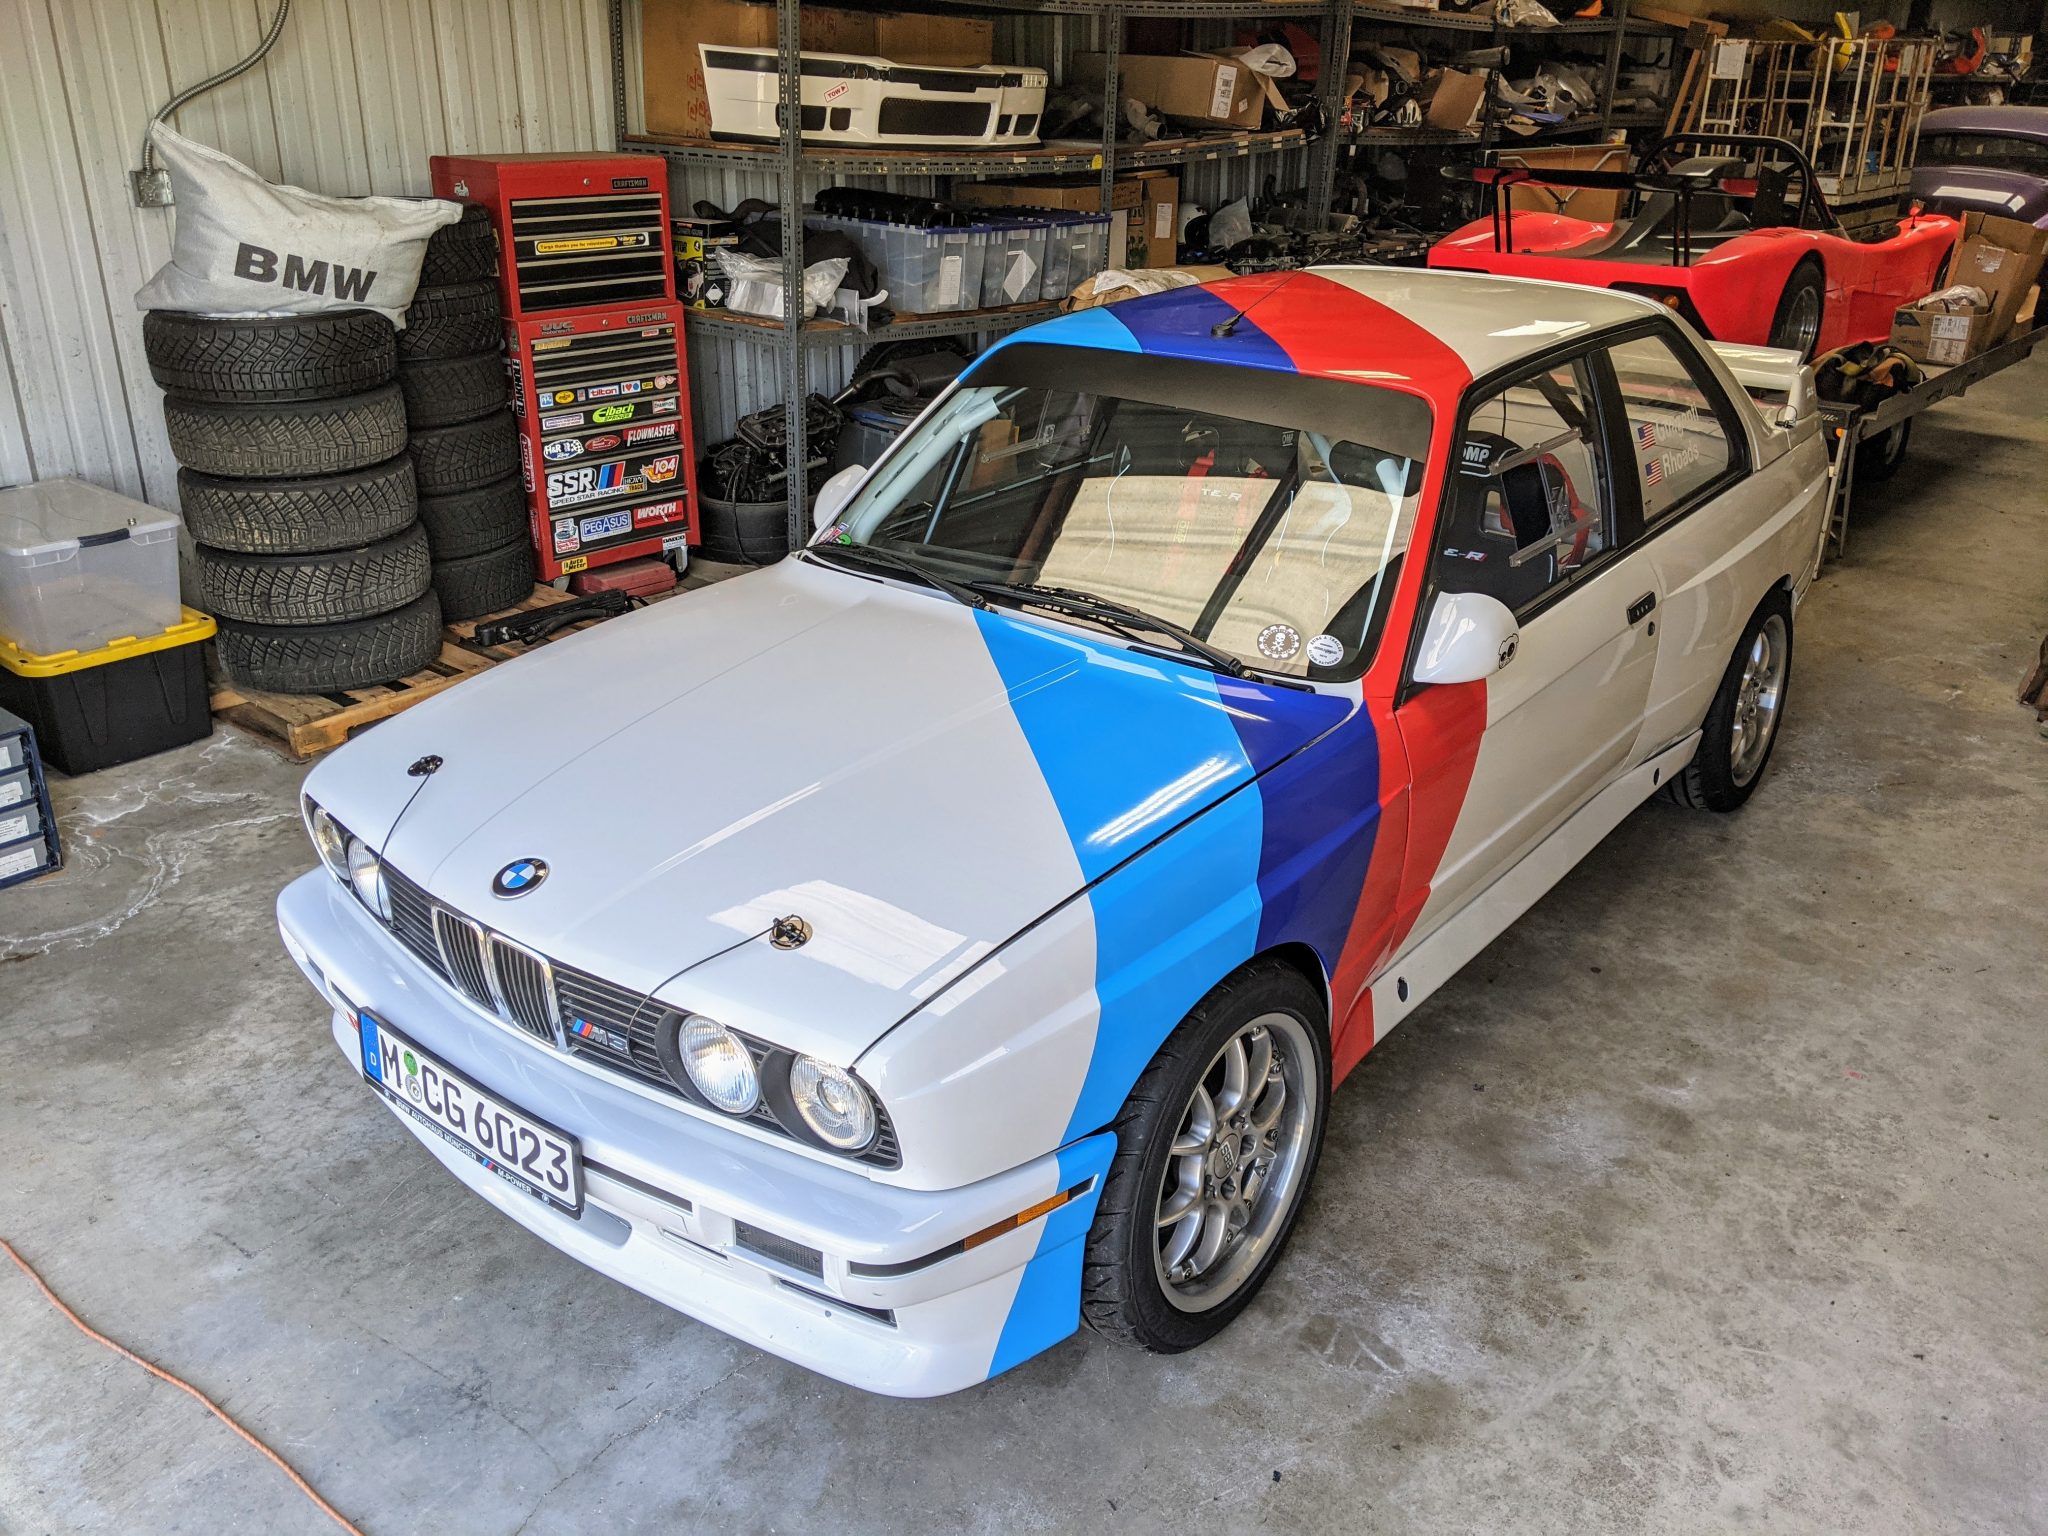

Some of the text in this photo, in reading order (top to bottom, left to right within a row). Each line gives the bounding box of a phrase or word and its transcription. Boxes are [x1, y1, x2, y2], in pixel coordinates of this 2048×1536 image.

[827, 88, 841, 98] TOW
[613, 179, 647, 188] CRAFTSMAN
[570, 242, 578, 250] you
[234, 242, 377, 303] BMW
[627, 312, 667, 324] CRAFTSMAN
[590, 388, 617, 397] tilton
[592, 403, 634, 422] Eibach
[627, 424, 675, 446] FLOWMASTER
[545, 443, 561, 454] H&R
[655, 458, 675, 474] 104
[1662, 440, 1699, 478] Rhoads
[547, 468, 597, 498] SSR
[551, 487, 624, 506] SPEED STAR RACING
[1201, 488, 1242, 501] TE-R
[637, 502, 677, 520] WORTH
[584, 515, 628, 534] PEGASUS
[569, 562, 586, 570] Meter
[570, 558, 584, 566] Auto
[589, 1023, 629, 1054] M3
[370, 1051, 377, 1066] D
[380, 1034, 569, 1193] M CG 6023
[395, 1099, 410, 1116] BMW
[411, 1108, 444, 1138] AUTOHAUS
[497, 1168, 532, 1195] M-POWER
